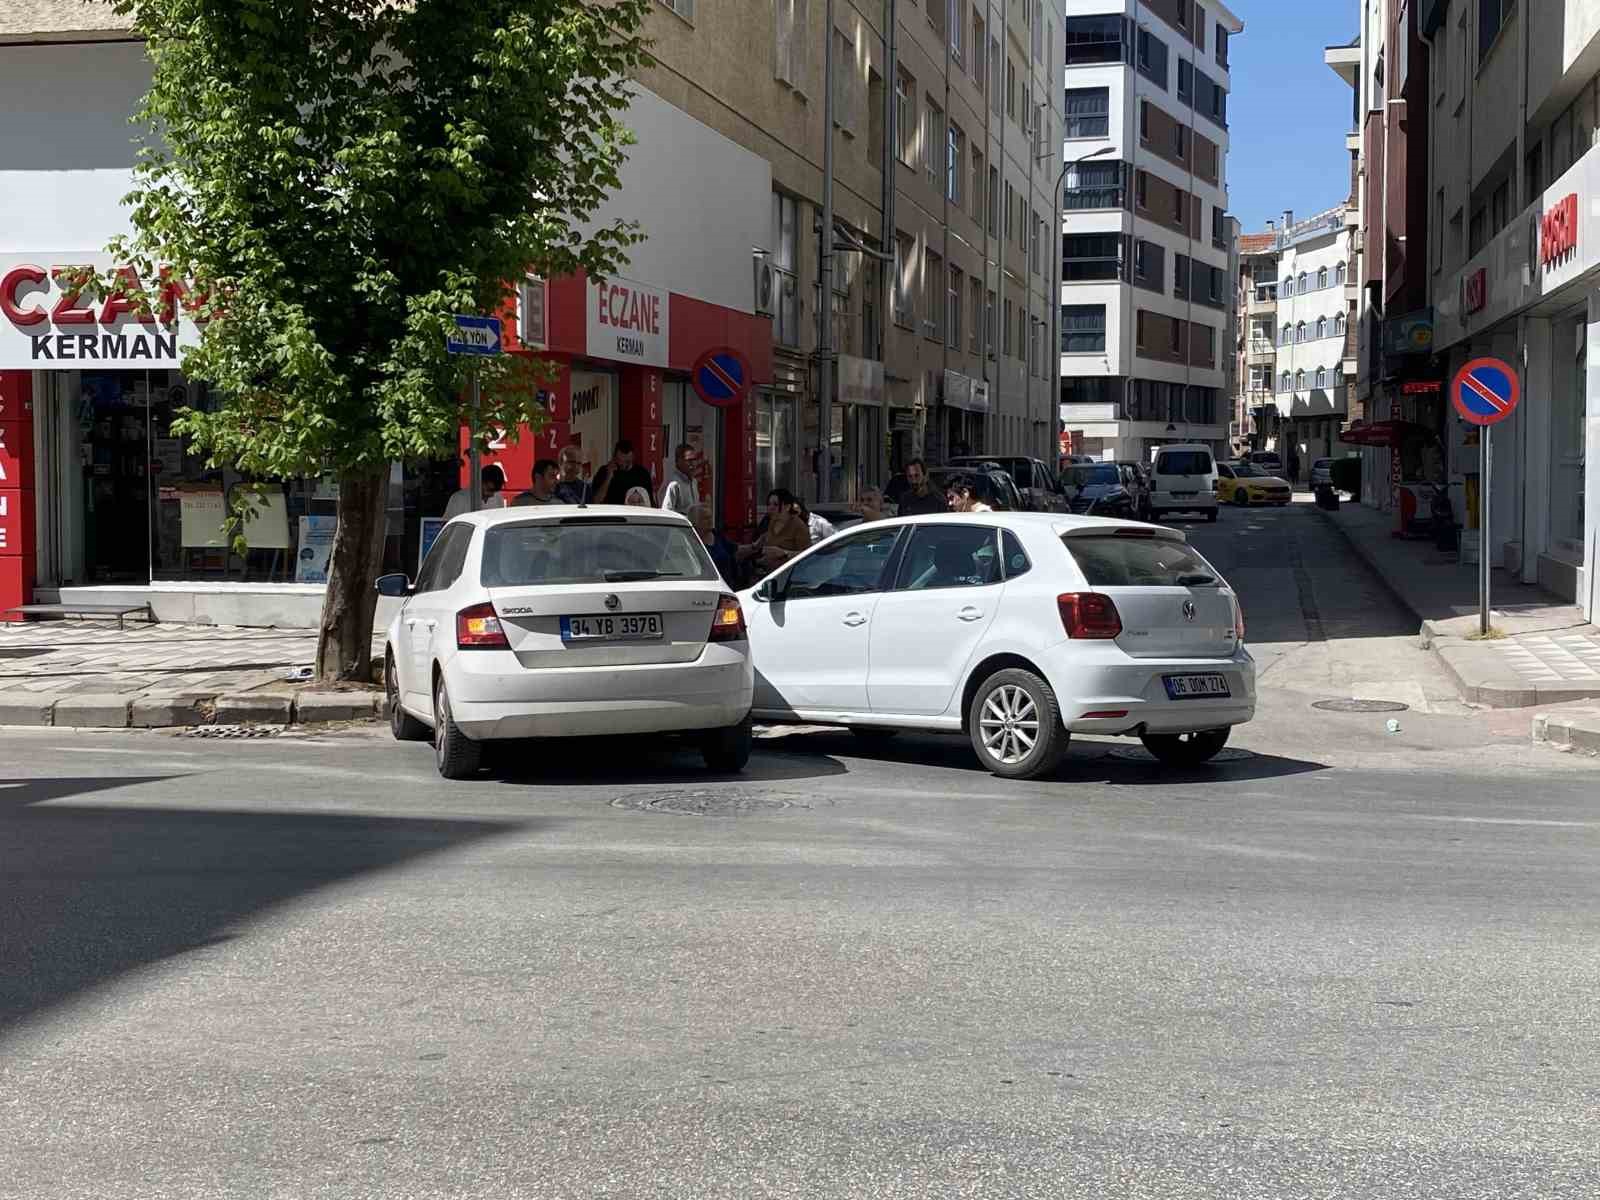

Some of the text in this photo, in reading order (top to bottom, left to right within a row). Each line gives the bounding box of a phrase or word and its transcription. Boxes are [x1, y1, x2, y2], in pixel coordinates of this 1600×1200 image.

[0, 264, 227, 325] CZAN
[599, 284, 660, 335] ECZANE
[32, 334, 176, 360] KERMAN
[470, 328, 487, 345] YÖN
[616, 335, 644, 357] KERMAN
[571, 616, 657, 635] 34 YB 3978
[1174, 678, 1186, 693] 06
